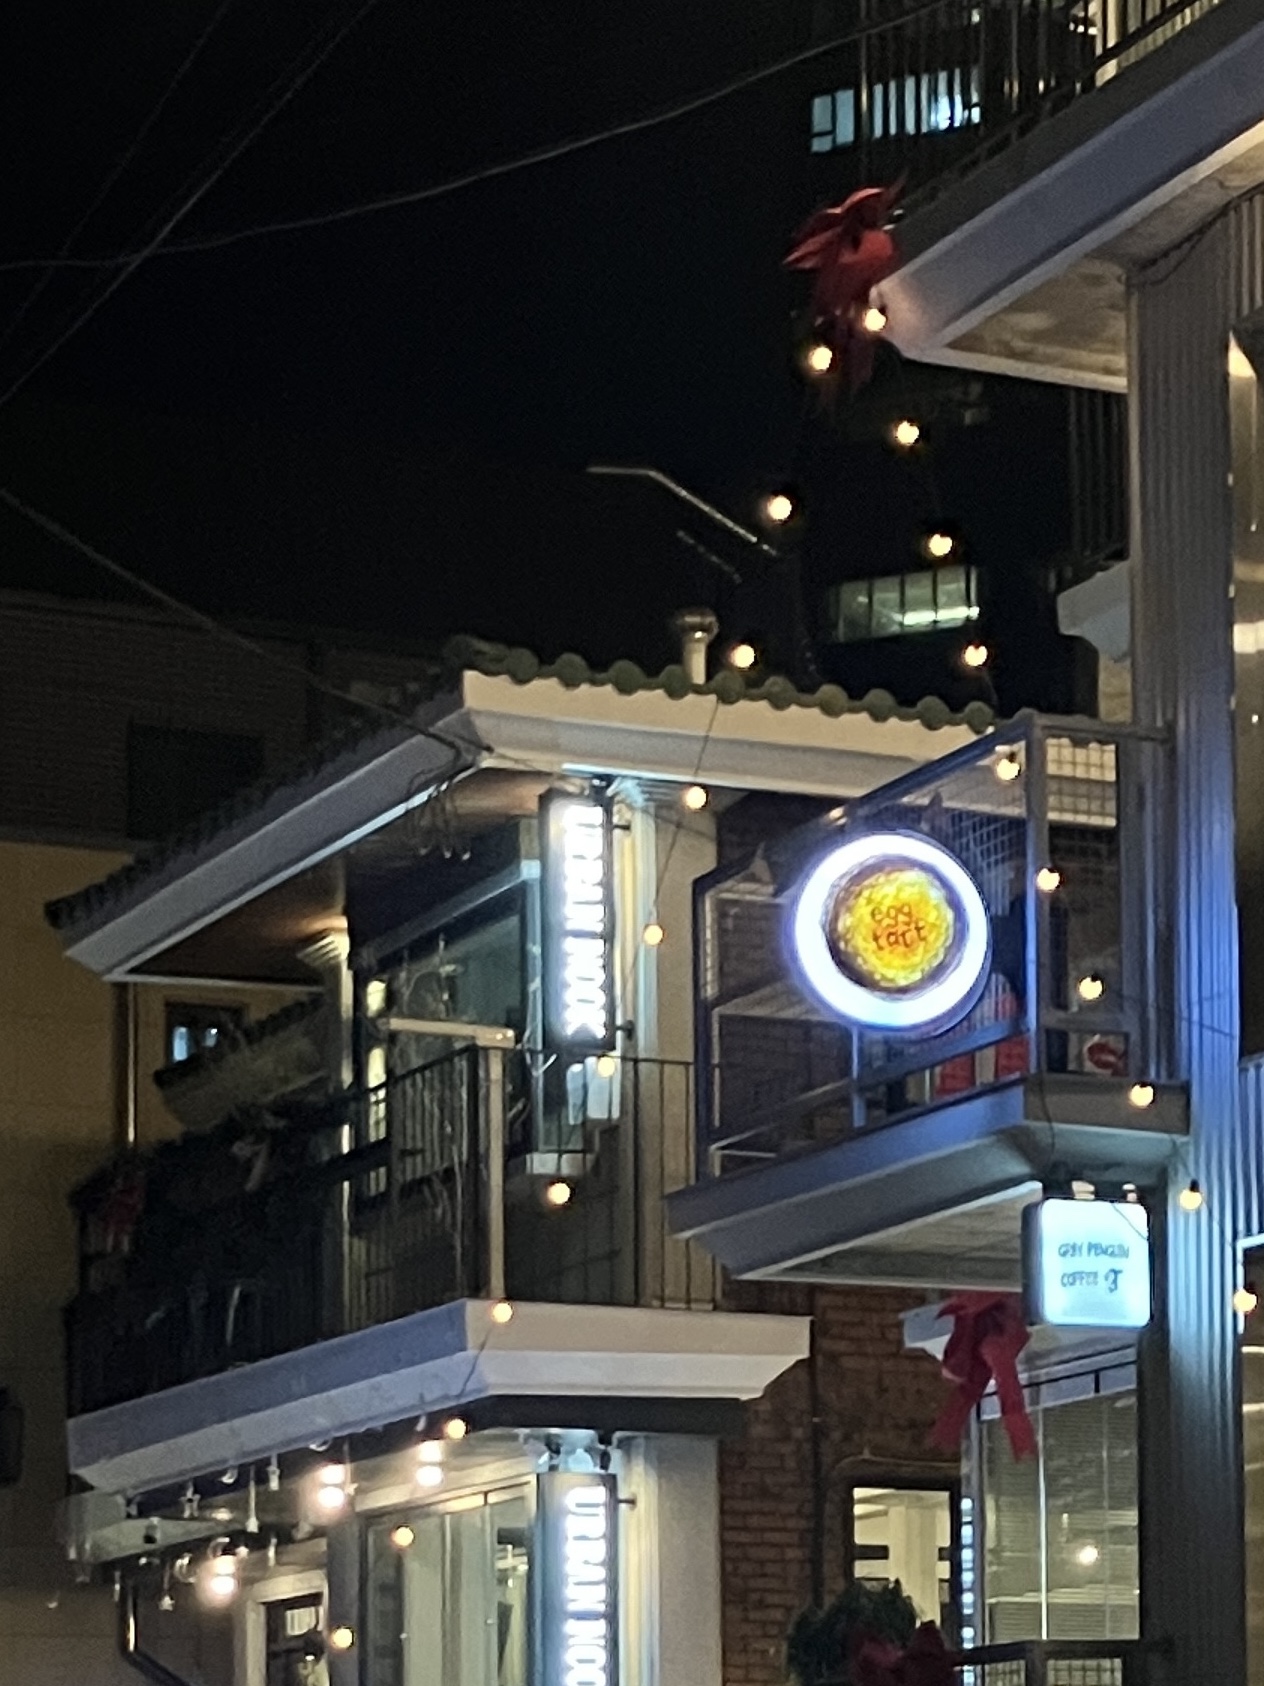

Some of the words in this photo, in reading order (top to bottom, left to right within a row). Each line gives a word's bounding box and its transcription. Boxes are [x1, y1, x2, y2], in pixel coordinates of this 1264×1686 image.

[563, 804, 605, 930] URBAN
[870, 902, 913, 926] egg
[872, 918, 928, 951] tart
[563, 937, 607, 1039] NOOK
[564, 1484, 607, 1612] URBAN
